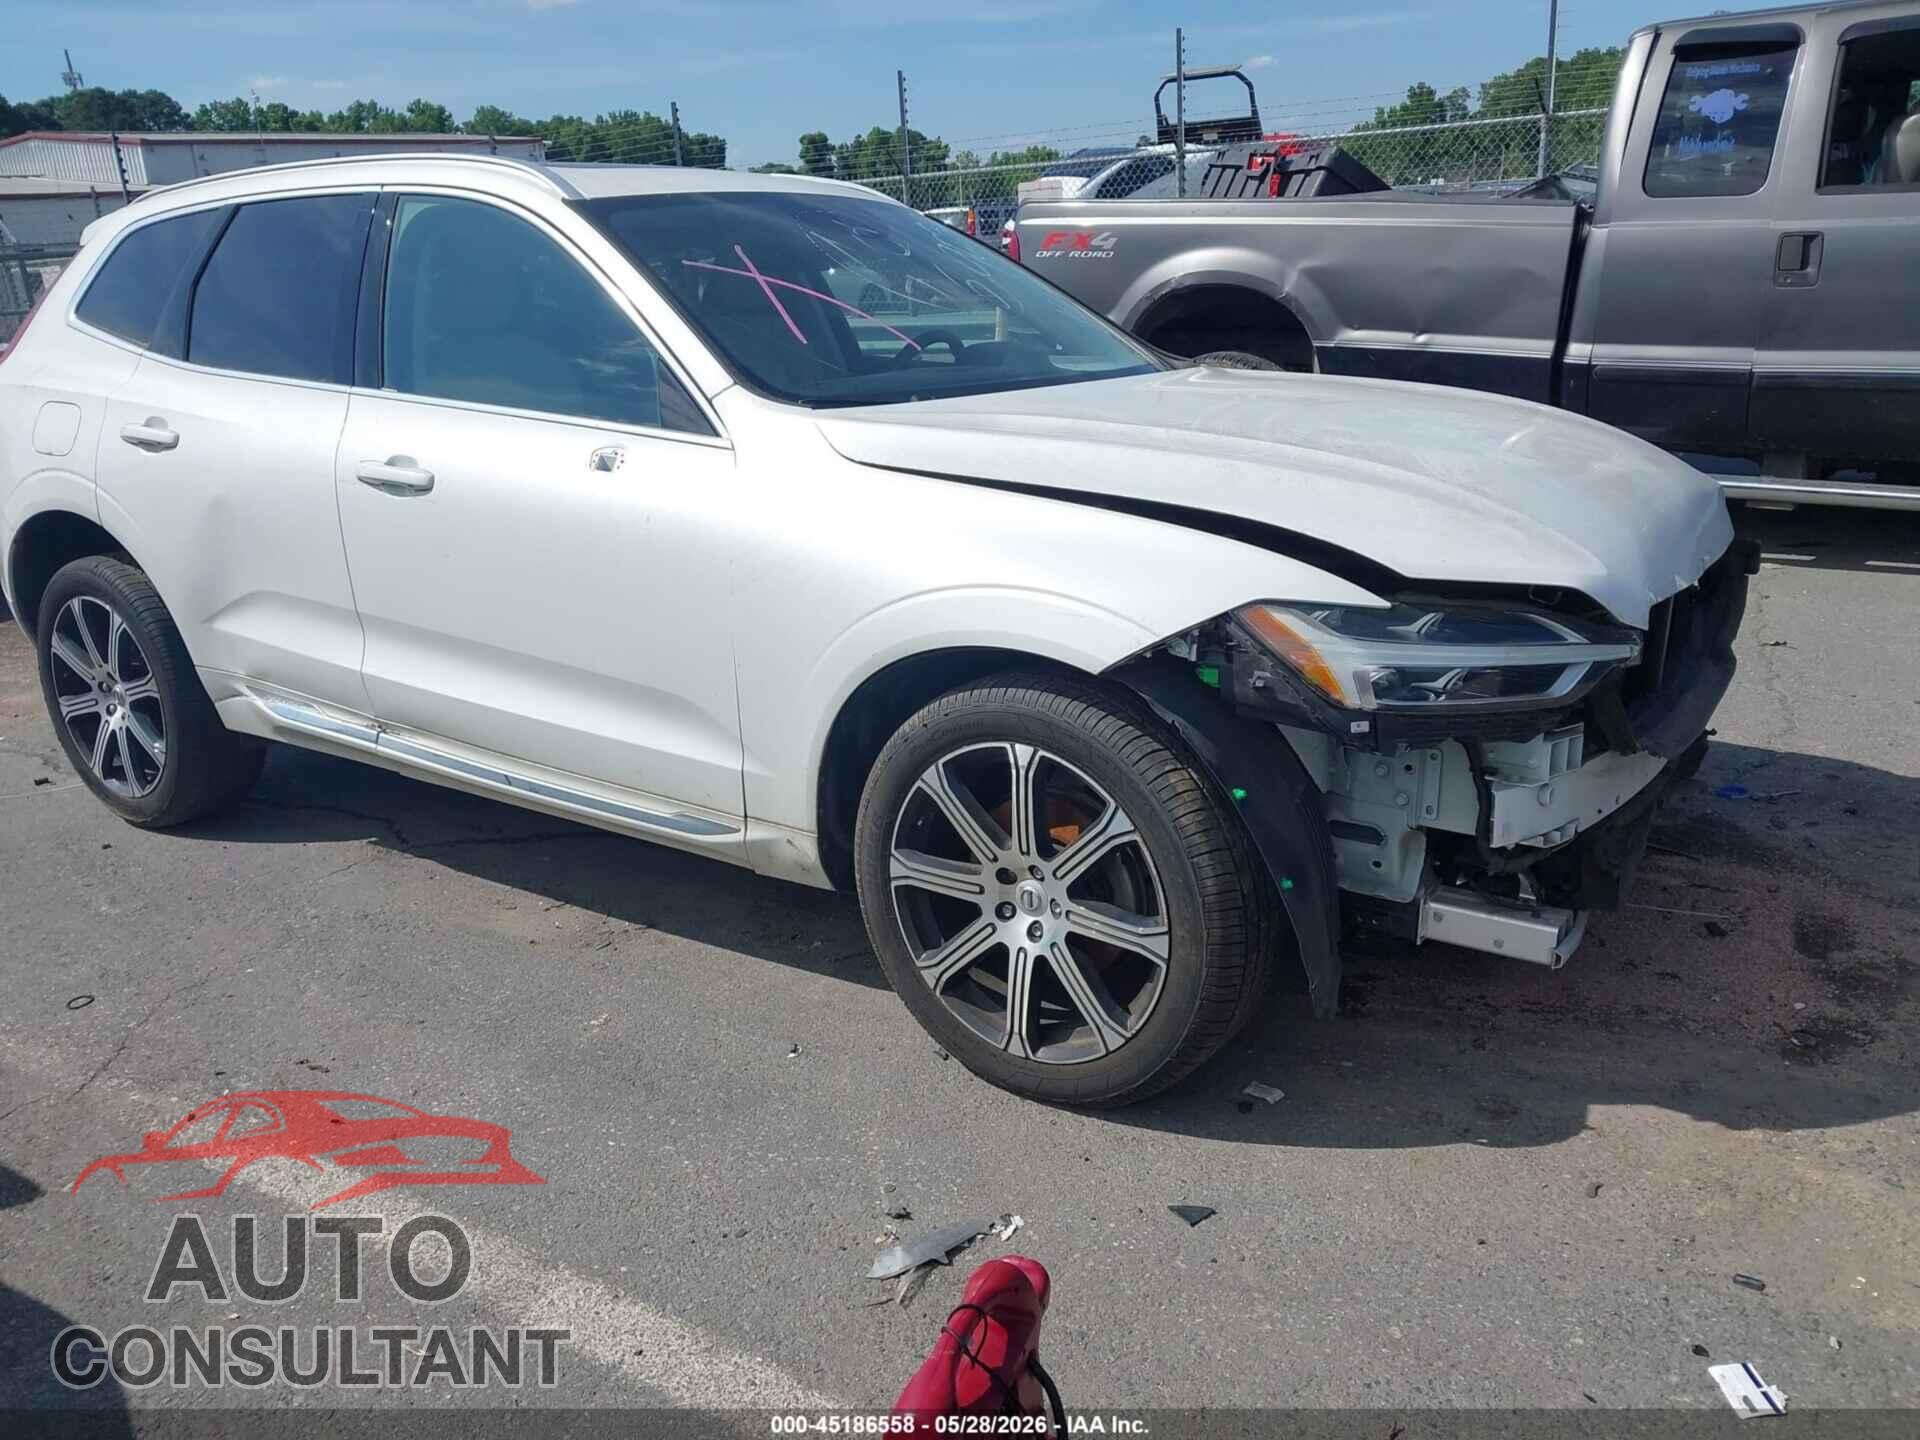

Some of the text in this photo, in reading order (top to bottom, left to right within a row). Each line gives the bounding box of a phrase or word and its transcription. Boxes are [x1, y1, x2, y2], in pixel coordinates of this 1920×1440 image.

[1040, 231, 1118, 251] FX4
[1035, 250, 1115, 258] OFF ROAD
